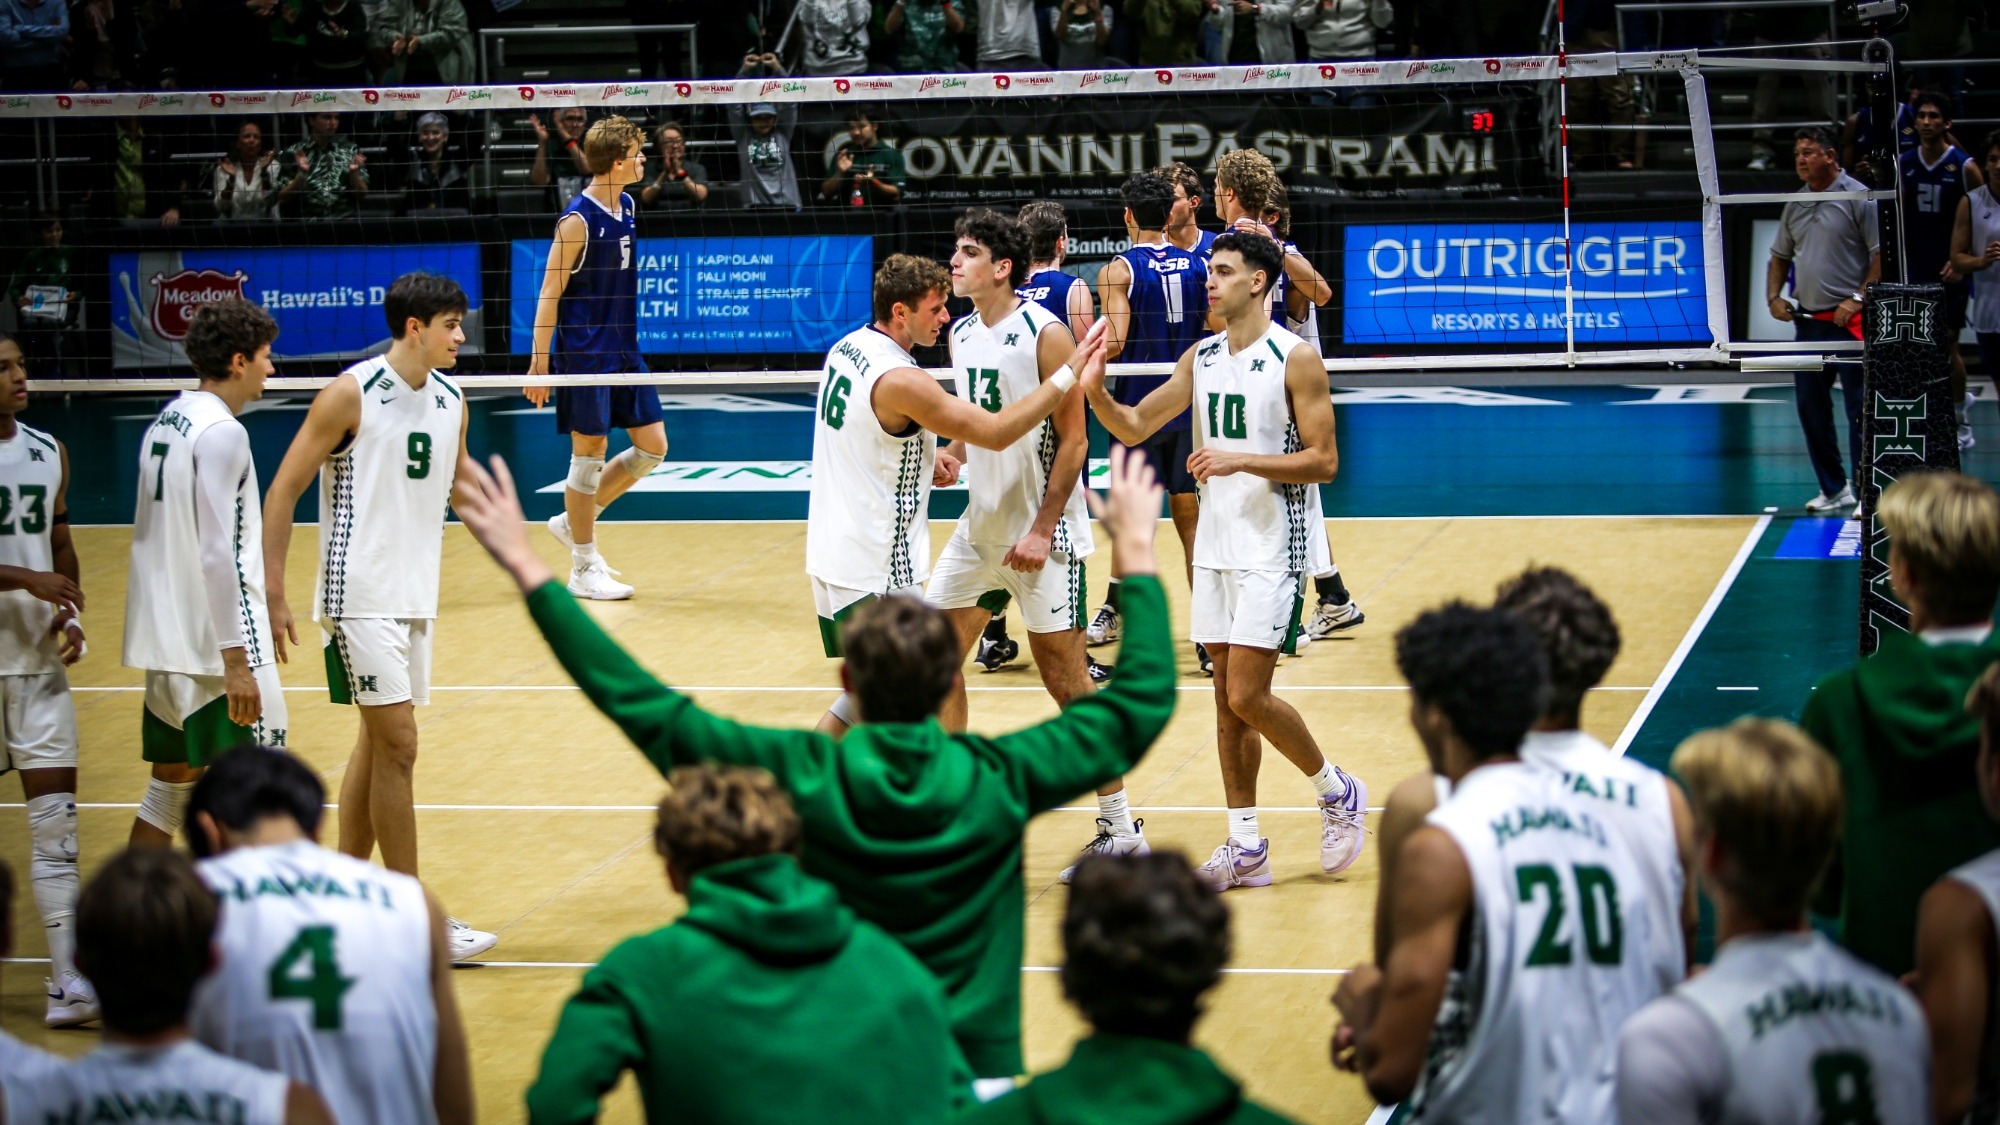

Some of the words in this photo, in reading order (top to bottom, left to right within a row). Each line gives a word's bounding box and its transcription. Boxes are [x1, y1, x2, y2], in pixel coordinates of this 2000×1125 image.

[1267, 69, 1291, 79] Bakery
[1431, 63, 1455, 74] Bakery
[1521, 61, 1545, 69] HAWAII
[783, 82, 806, 93] Bakery
[942, 78, 966, 88] Bakery
[1104, 73, 1128, 84] Bakery
[313, 93, 336, 103] Bakery
[468, 90, 491, 100] Bakery
[625, 86, 648, 96] Bakery
[1917, 183, 1942, 213] 21
[619, 235, 631, 270] 5
[1367, 236, 1687, 280] OUTRIGGER
[637, 277, 679, 294] IFIC
[697, 271, 726, 283] PALI
[730, 270, 767, 283] MOMI
[163, 286, 238, 305] Meadow
[697, 288, 750, 300] STRAUB
[697, 304, 750, 317] WILCOX
[1432, 312, 1520, 330] RESORTS
[1524, 312, 1538, 330] &
[1542, 311, 1620, 330] HOTELS
[821, 365, 852, 431] 16
[966, 367, 1003, 414] 13
[1207, 392, 1248, 440] 10
[406, 431, 432, 480] 9
[151, 441, 170, 502] 7
[0, 484, 48, 536] 23
[1515, 863, 1625, 968] 20
[269, 924, 359, 1032] 4
